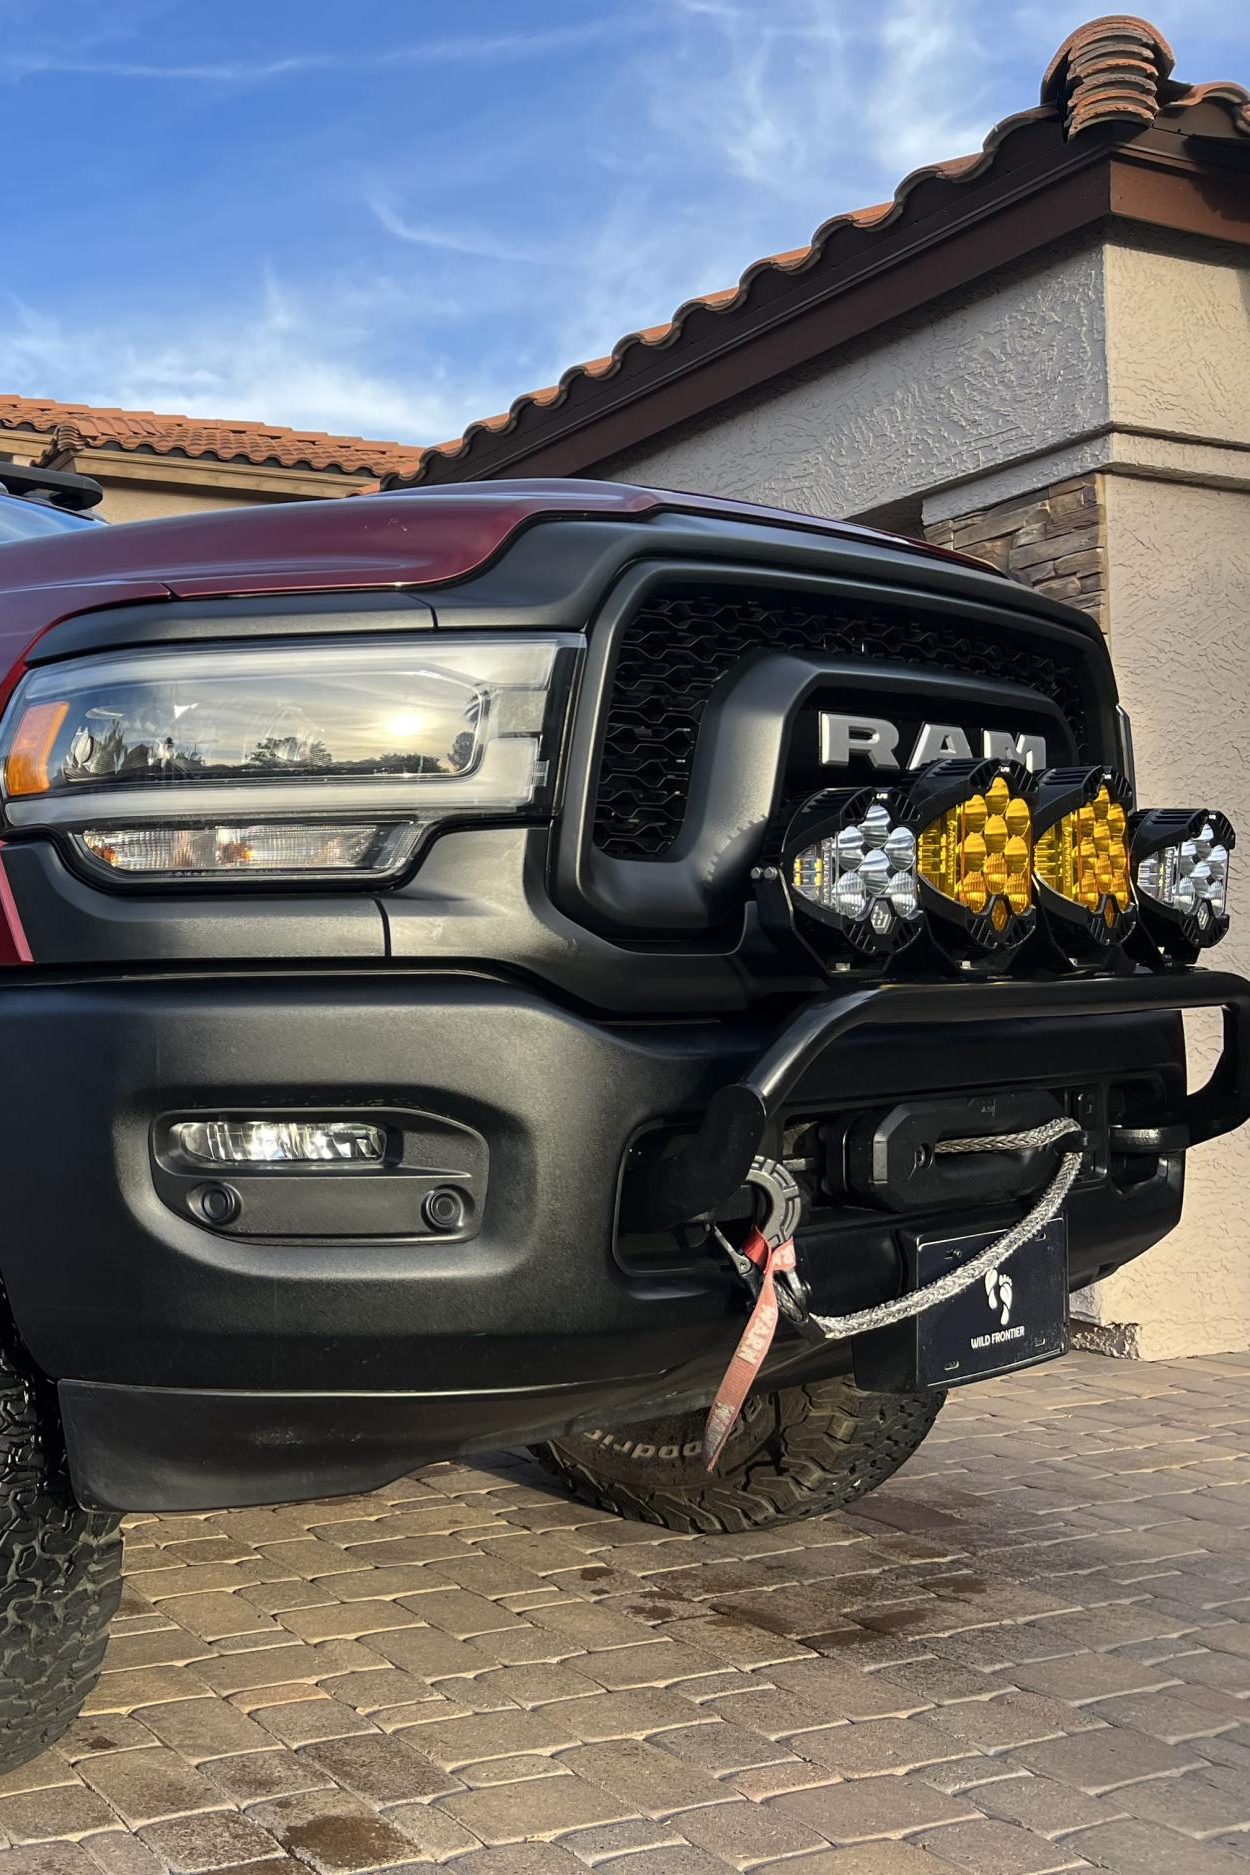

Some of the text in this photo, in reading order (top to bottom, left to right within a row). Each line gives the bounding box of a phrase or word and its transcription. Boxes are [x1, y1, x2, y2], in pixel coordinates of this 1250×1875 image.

[818, 710, 1047, 774] RAM
[970, 1326, 1025, 1349] WILD FRONTIER
[584, 1429, 702, 1459] oodric
